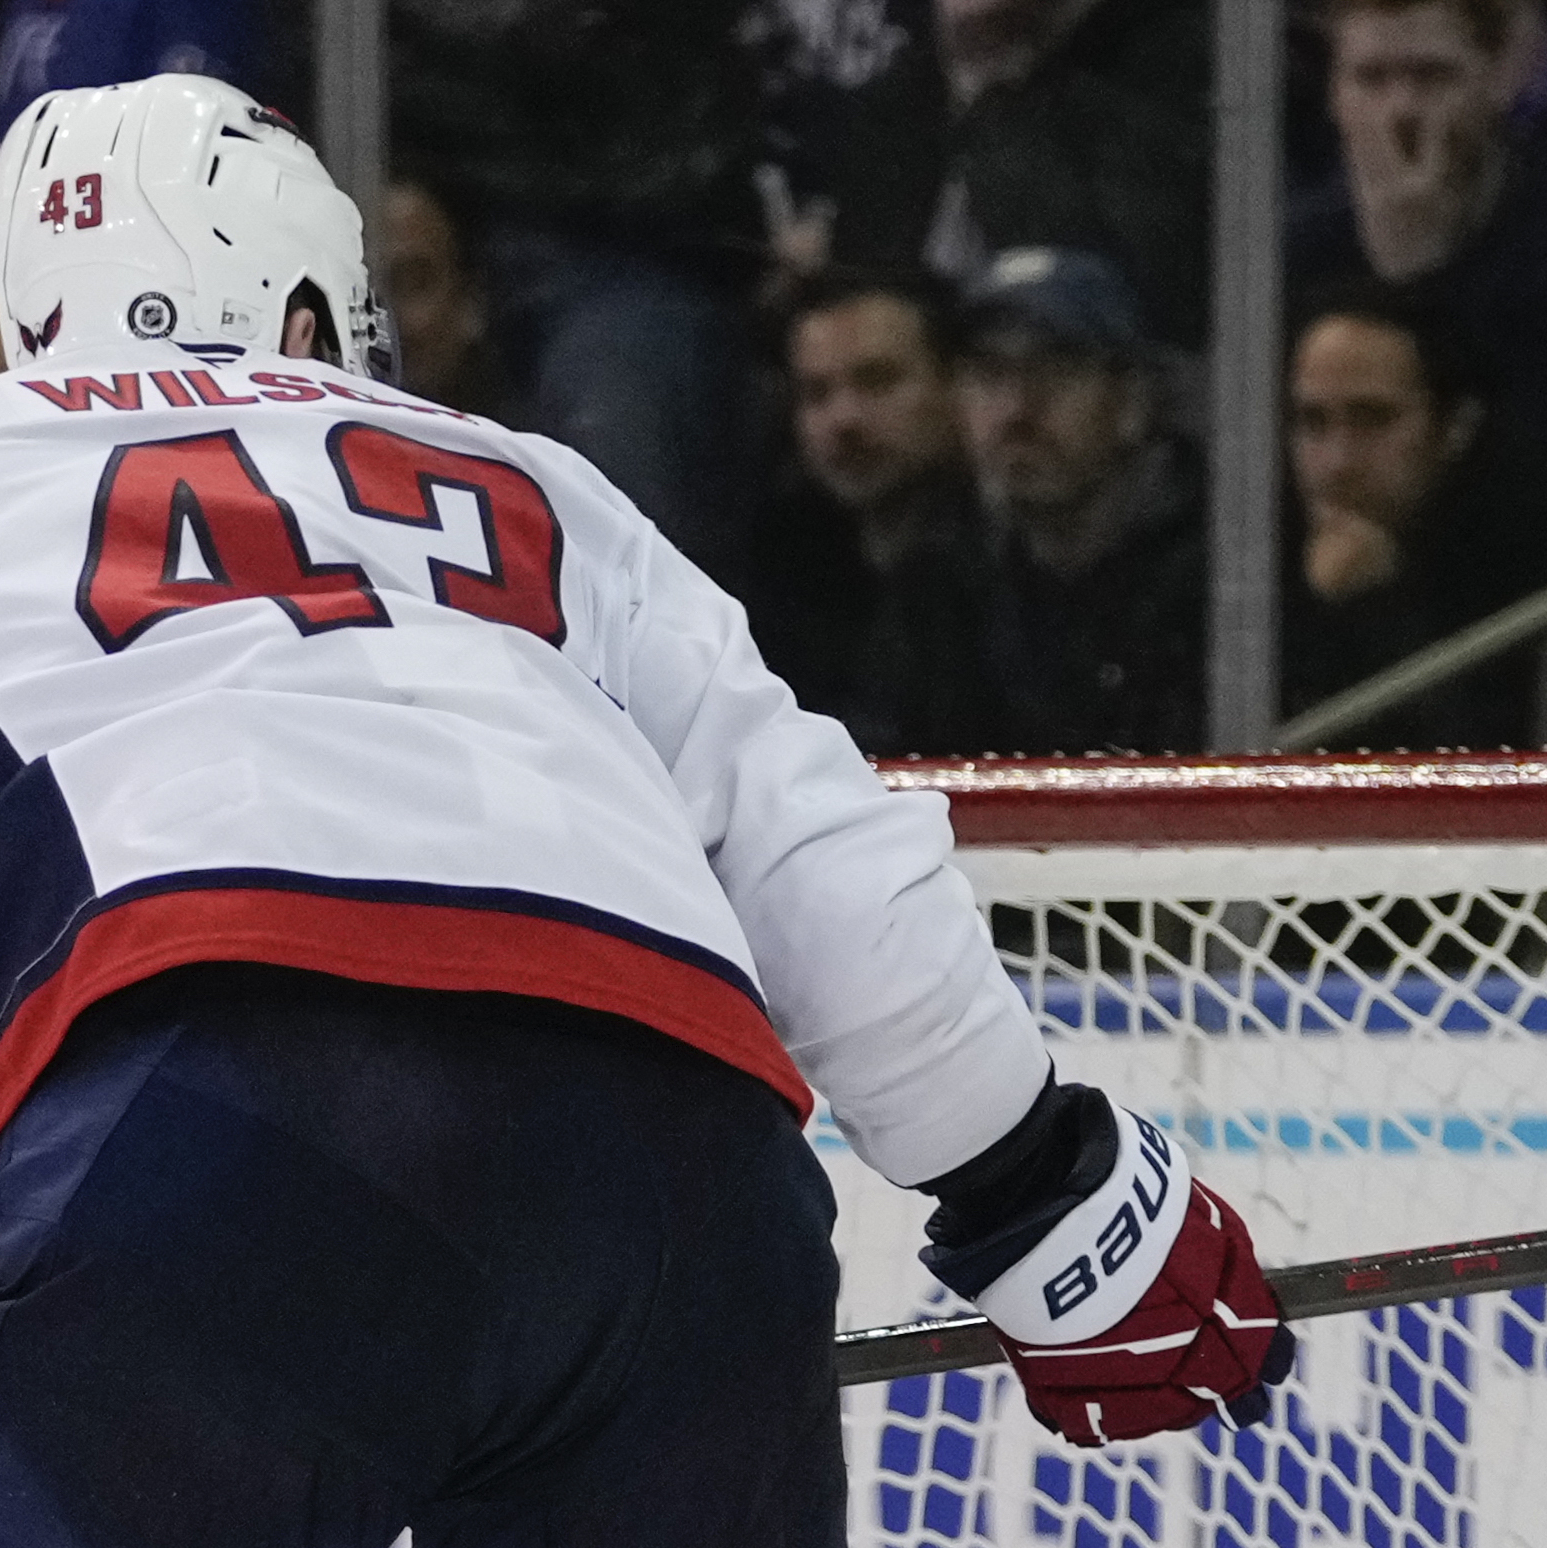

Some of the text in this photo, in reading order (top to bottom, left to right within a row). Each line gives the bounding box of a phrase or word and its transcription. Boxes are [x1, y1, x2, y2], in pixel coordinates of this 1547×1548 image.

[39, 172, 104, 234] 43
[75, 419, 568, 655] 43
[1042, 1105, 1171, 1321] BAUE
